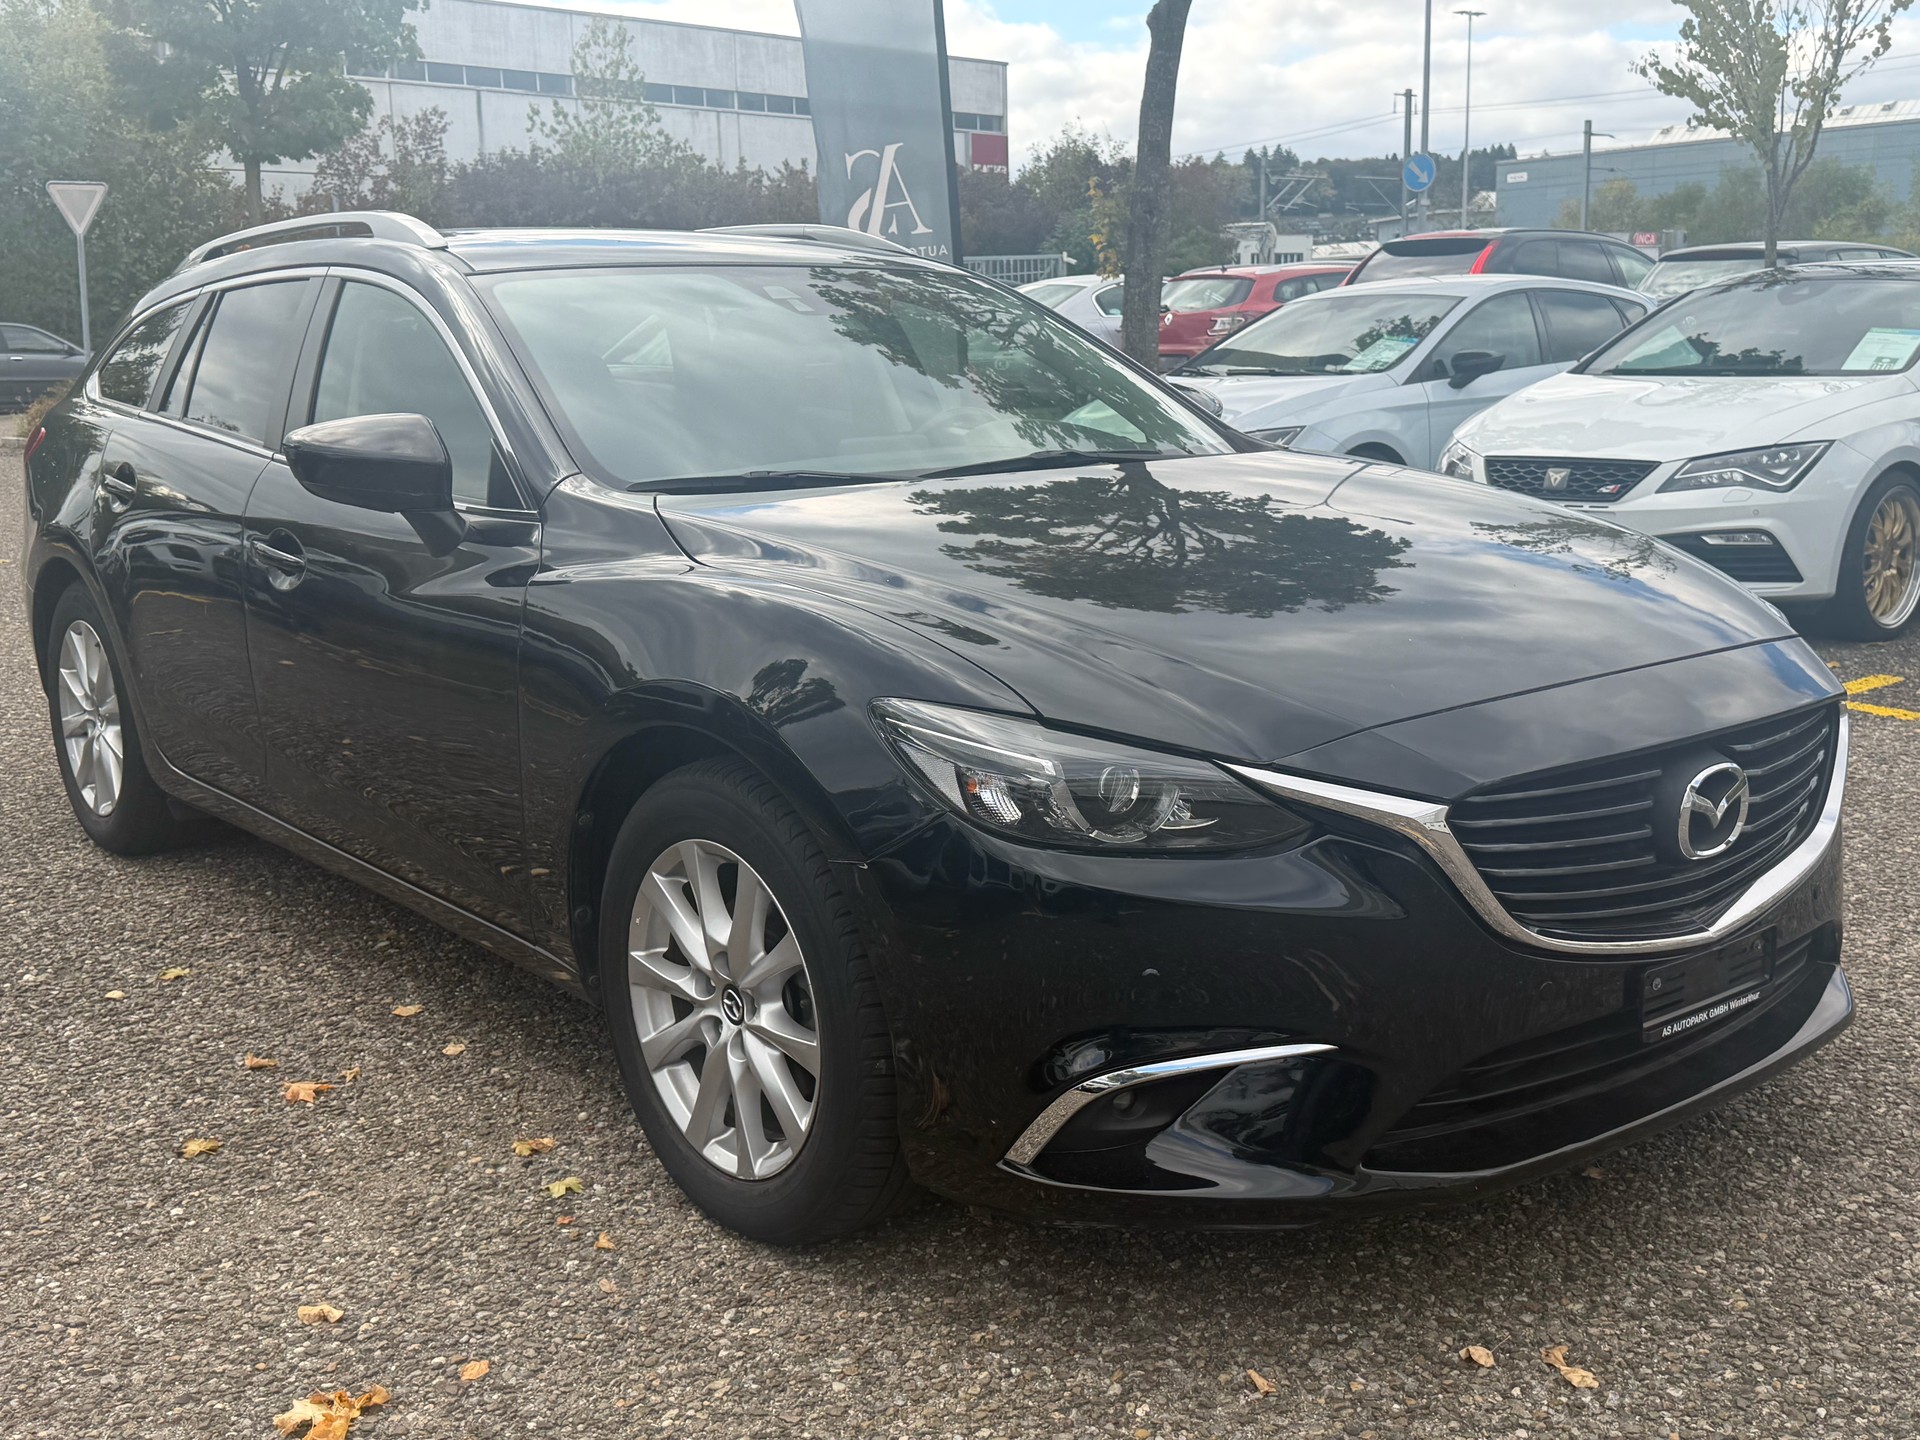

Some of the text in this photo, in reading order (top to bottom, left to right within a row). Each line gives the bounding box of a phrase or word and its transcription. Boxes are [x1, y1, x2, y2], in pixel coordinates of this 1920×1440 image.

[1661, 991, 1761, 1038] AS AUTOPARK GMBH Winterthur
